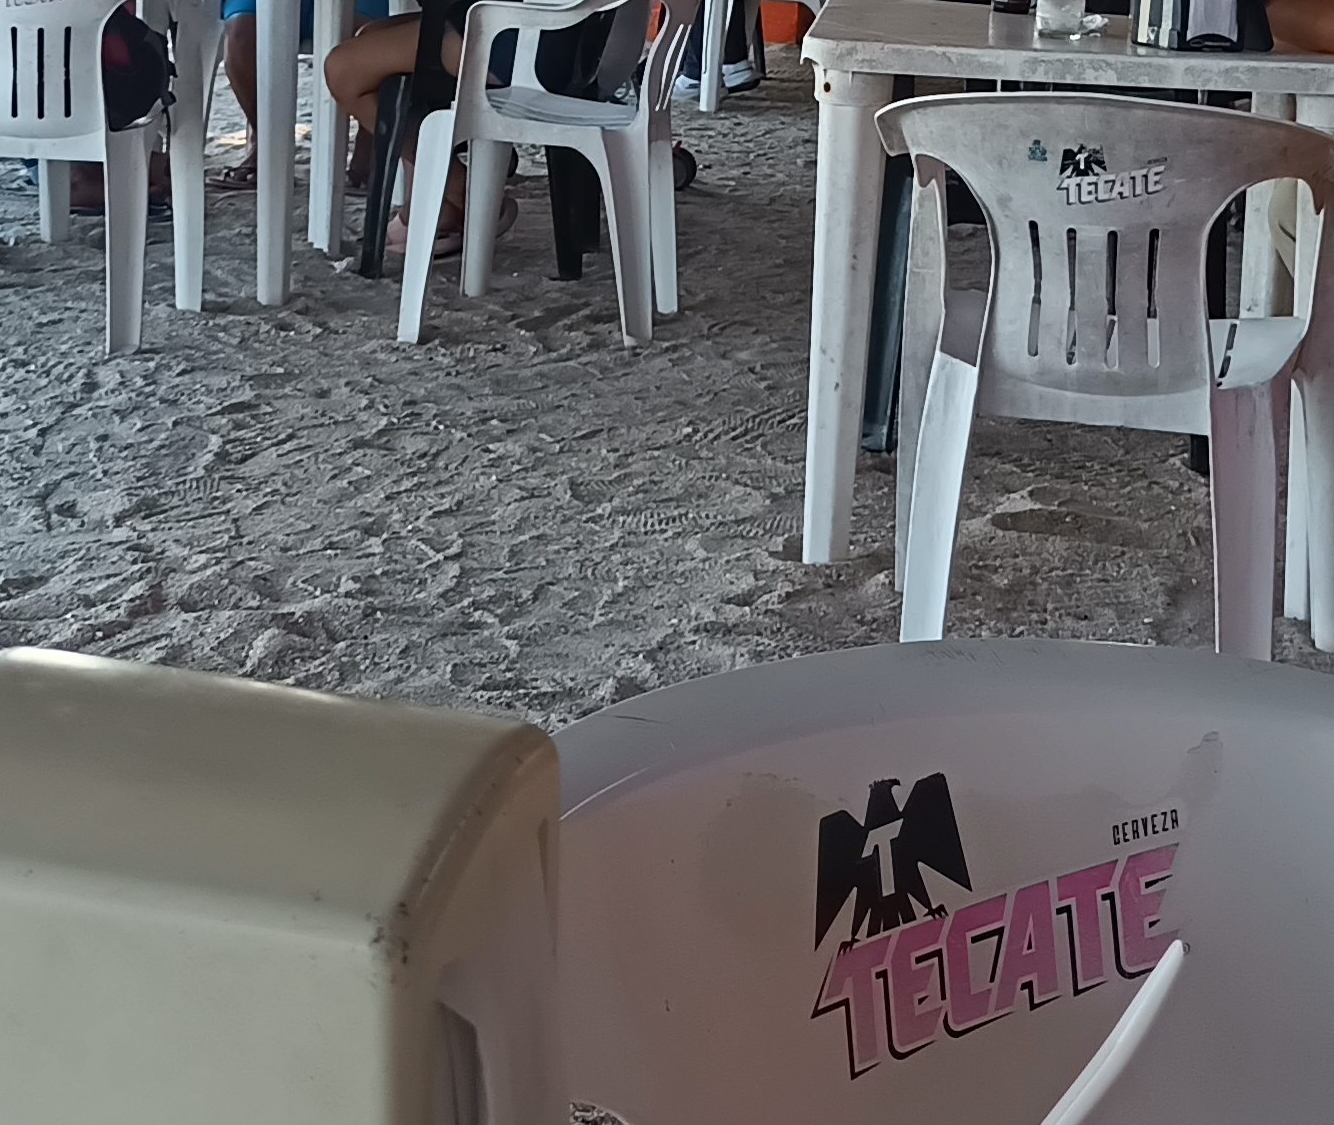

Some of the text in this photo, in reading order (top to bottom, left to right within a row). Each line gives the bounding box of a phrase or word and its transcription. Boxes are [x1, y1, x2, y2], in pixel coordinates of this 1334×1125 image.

[1056, 165, 1166, 206] TECATE
[1112, 808, 1179, 845] CERVEZA
[811, 842, 1180, 1081] TECATE
